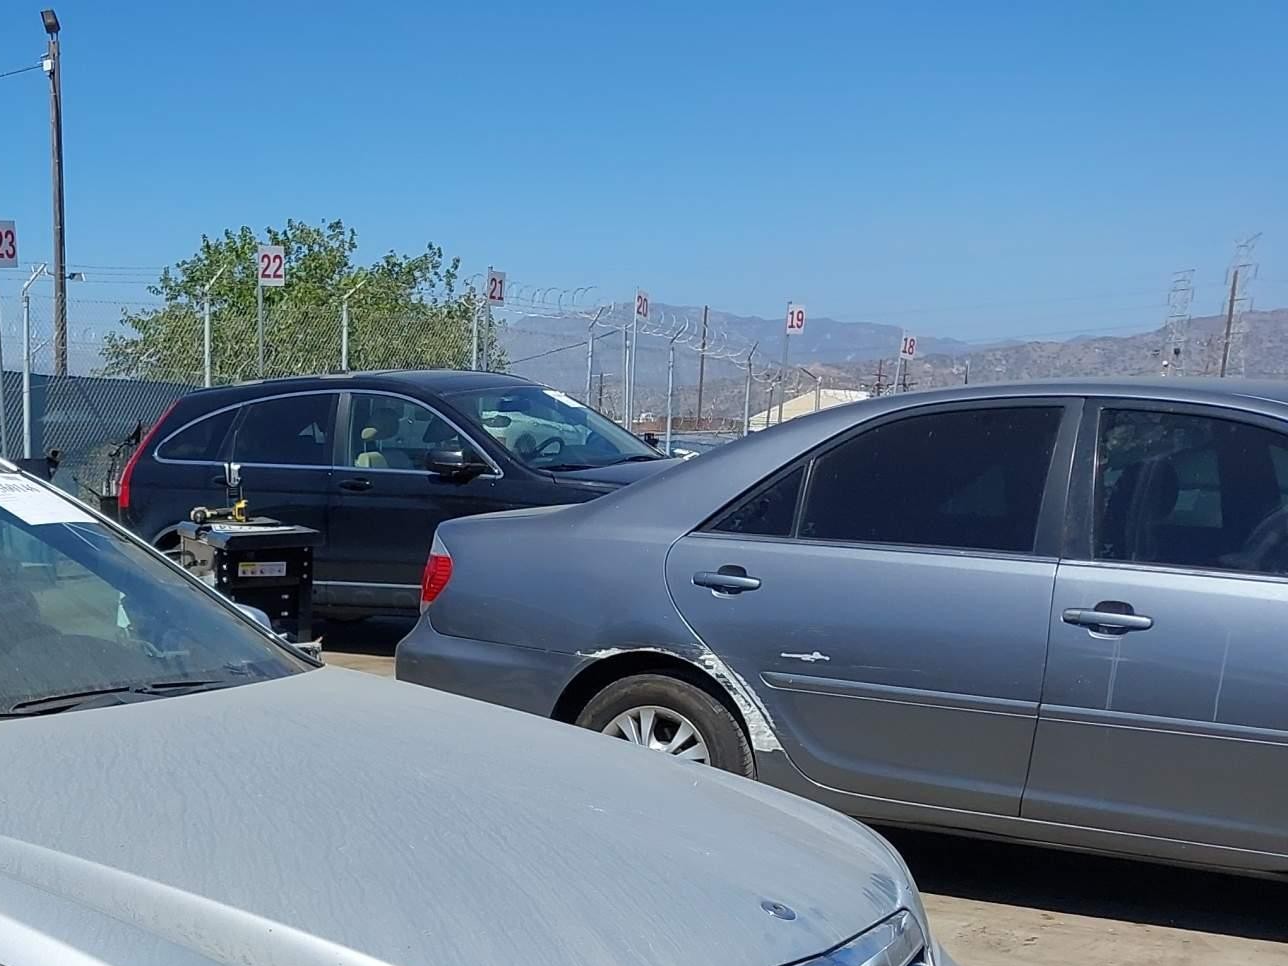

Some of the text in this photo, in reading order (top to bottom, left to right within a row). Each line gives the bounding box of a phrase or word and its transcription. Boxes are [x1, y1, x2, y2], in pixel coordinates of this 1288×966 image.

[261, 254, 284, 279] 22
[489, 277, 504, 301] 21
[637, 295, 648, 317] 20
[788, 310, 804, 329] 19
[902, 337, 916, 355] 18
